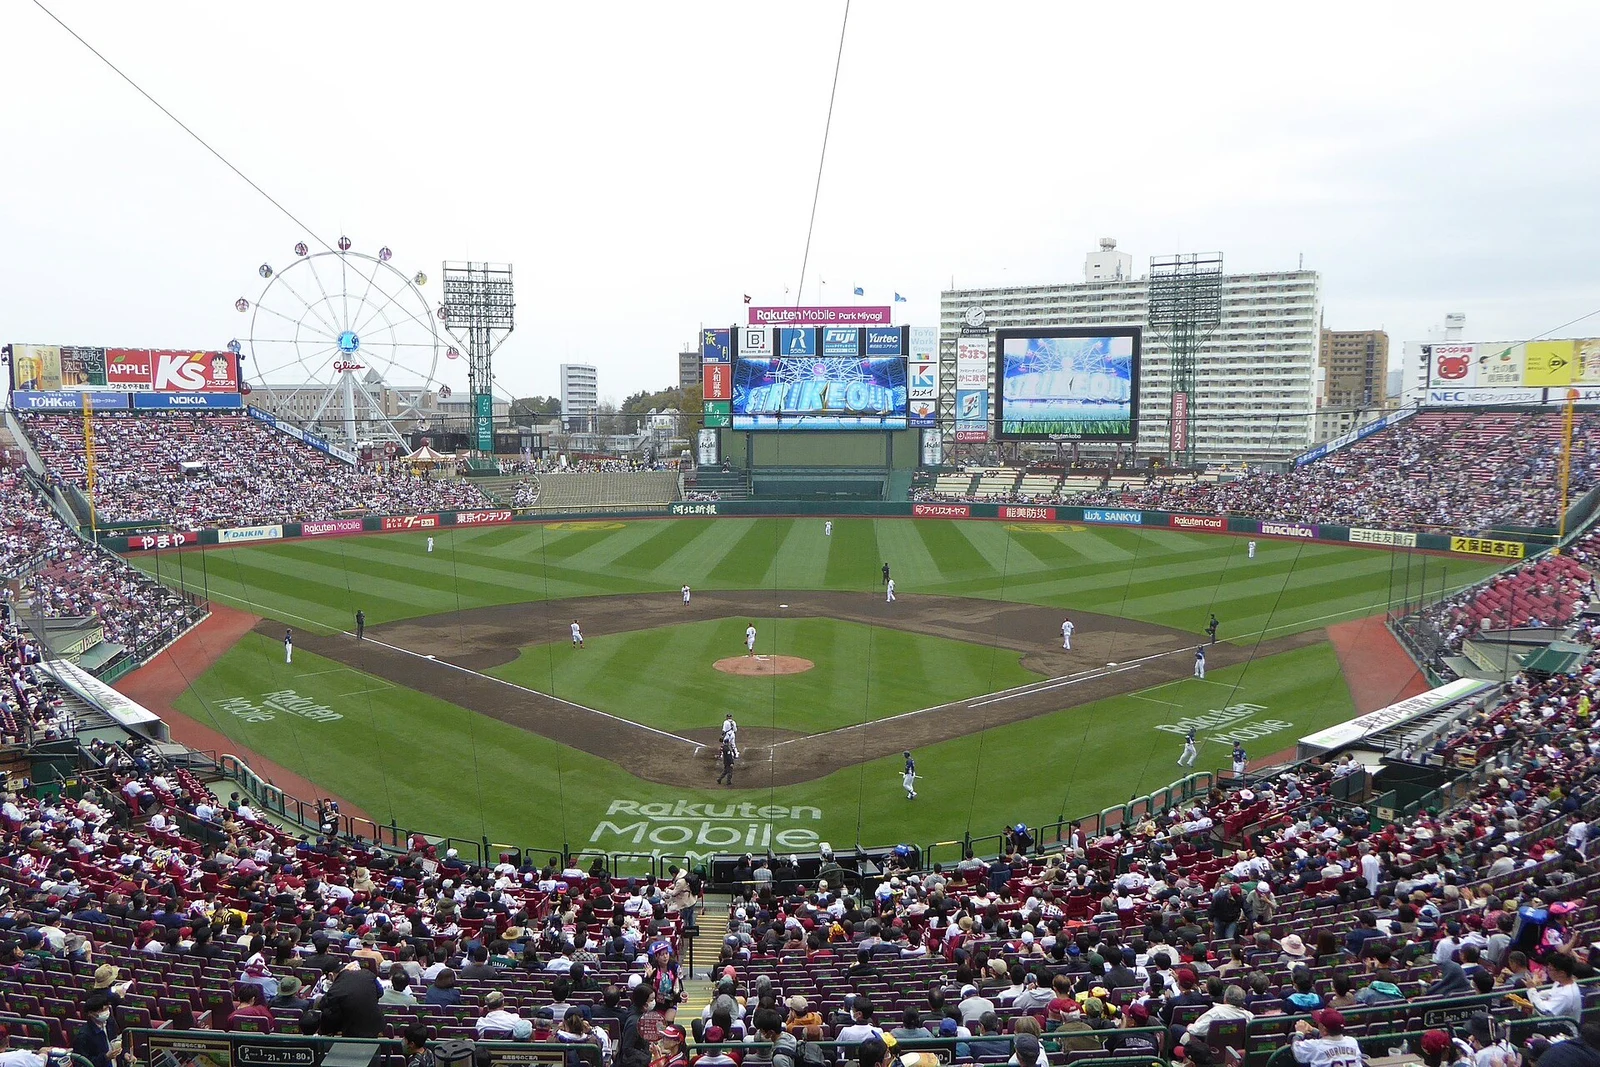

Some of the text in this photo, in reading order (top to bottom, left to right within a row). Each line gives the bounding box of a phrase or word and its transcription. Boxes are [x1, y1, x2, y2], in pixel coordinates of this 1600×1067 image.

[757, 309, 883, 322] Rakuten Mobile Park Miyagi
[825, 329, 857, 343] Fuji
[868, 332, 899, 344] Yurtec
[108, 363, 150, 375] APPLE
[333, 360, 366, 373] Glico
[712, 366, 721, 398] 大和証券
[912, 388, 934, 397] カメイ
[1430, 391, 1465, 402] NEC
[169, 396, 207, 404] NOKIA
[1174, 394, 1183, 449] 三井のリハウス
[672, 504, 718, 516] 河北新報
[924, 506, 967, 515] アイリスオーヤマ
[1006, 507, 1047, 519] 能美防災
[1084, 510, 1141, 523] 山九 SANKYU
[456, 511, 512, 524] 東京インテリア
[1173, 516, 1222, 528] Rakuten Card
[303, 520, 361, 534] Rakuten Mobile
[141, 532, 186, 549] やまや
[232, 529, 264, 539] DAIKIN
[1350, 530, 1415, 546] 三井住友銀行
[1455, 538, 1520, 556] 久保田本店
[261, 689, 344, 723] Rakuten
[1154, 702, 1269, 735] Rakuten
[1203, 719, 1294, 746] Mobile
[605, 799, 822, 821] Rakuten
[589, 820, 820, 848] Mobile
